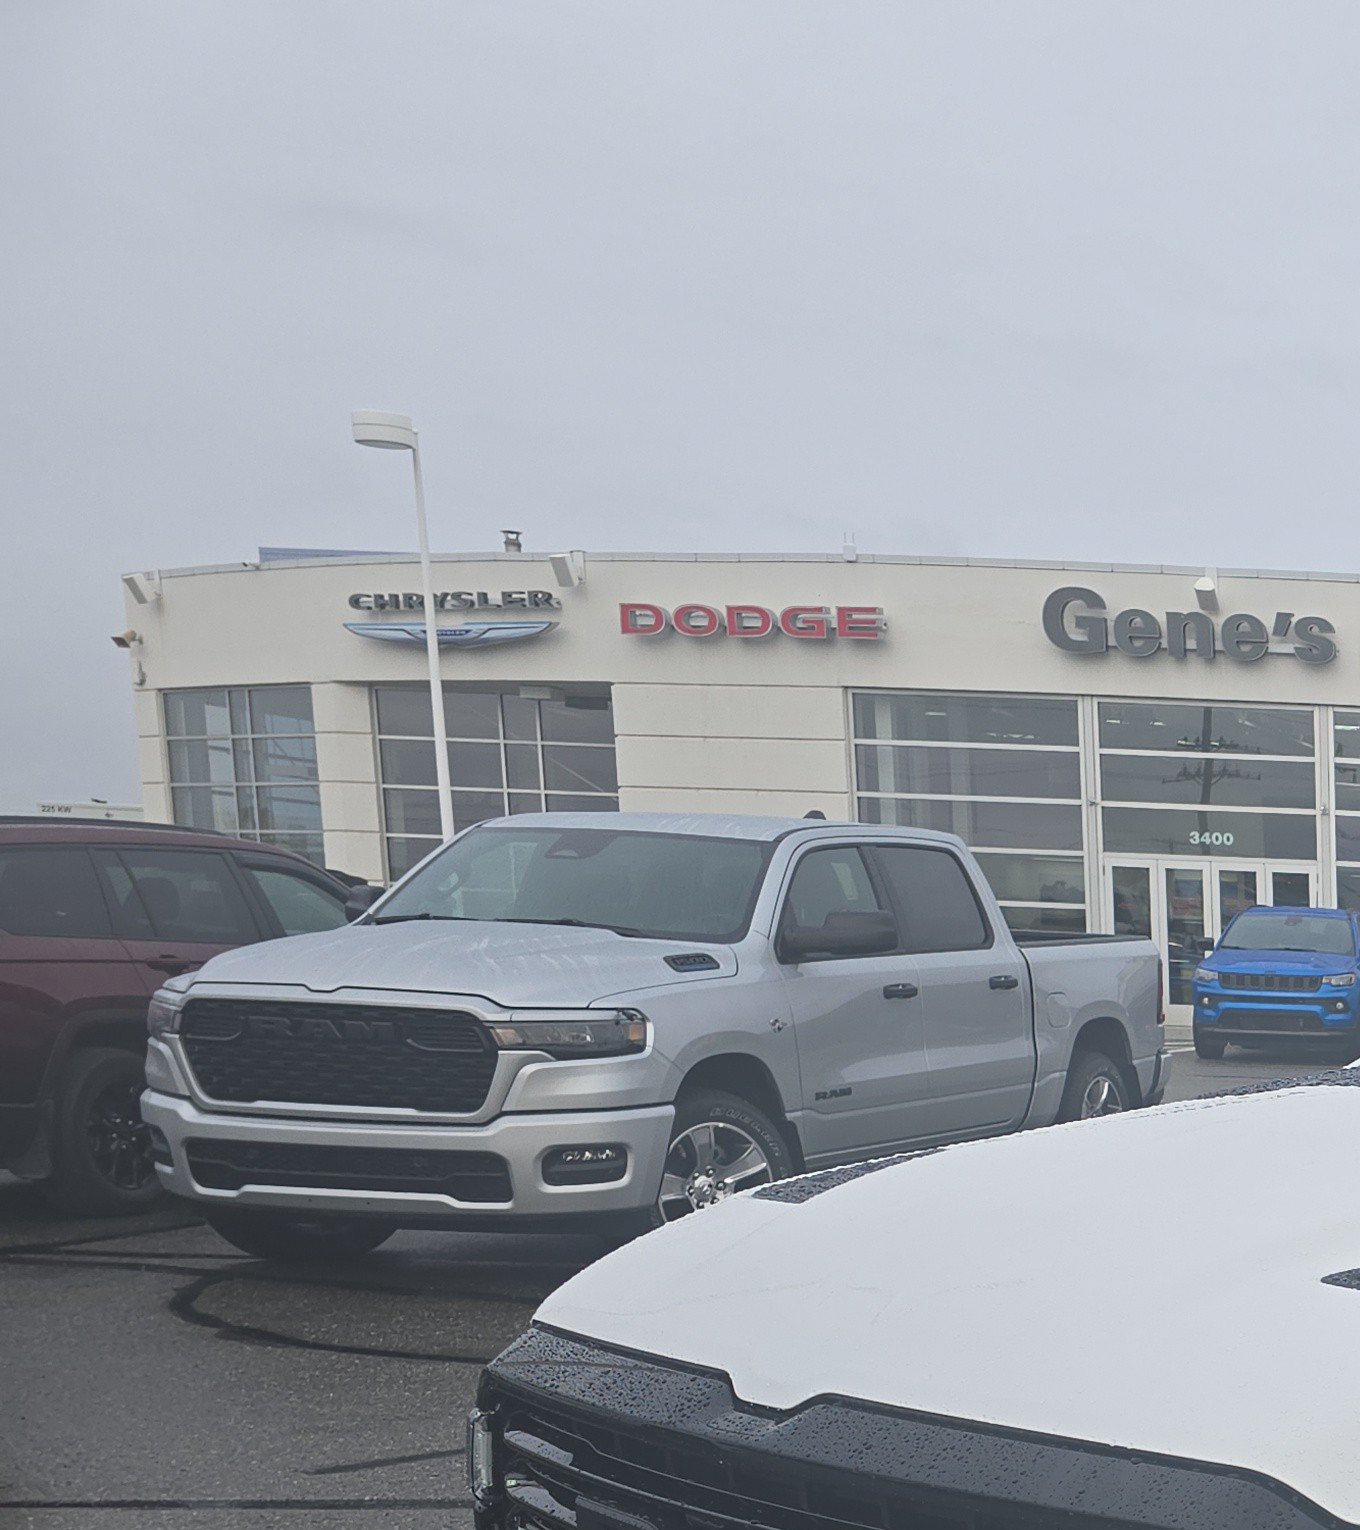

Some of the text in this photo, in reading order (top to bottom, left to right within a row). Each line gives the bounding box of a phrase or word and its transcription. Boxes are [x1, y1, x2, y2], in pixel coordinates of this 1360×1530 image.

[348, 590, 560, 611] CHRYSLER
[619, 603, 884, 639] DODGE
[1042, 586, 1336, 664] Gene's
[1189, 830, 1234, 846] 3400
[247, 1015, 398, 1043] RAM
